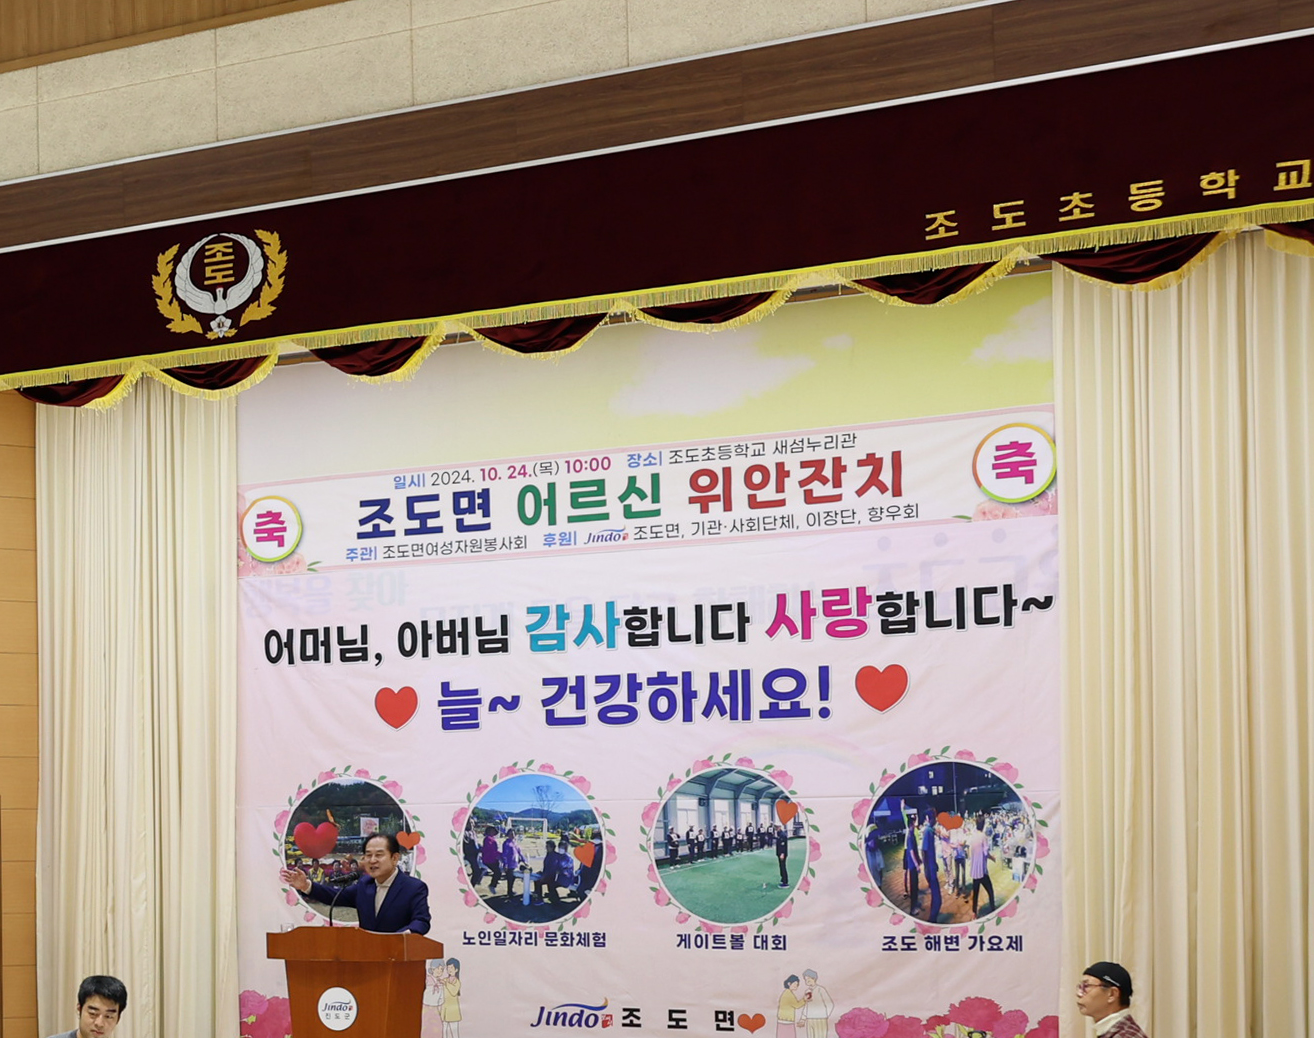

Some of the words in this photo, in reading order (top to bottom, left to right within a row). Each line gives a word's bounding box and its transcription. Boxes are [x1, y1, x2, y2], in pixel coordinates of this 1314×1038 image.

[204, 241, 235, 286] 조도
[430, 469, 475, 487] 2024.
[479, 467, 502, 482] 10.
[564, 456, 612, 474] 10:00
[668, 441, 766, 465] 조도초등학교
[772, 432, 857, 456] 새섬누리관
[989, 437, 1039, 484] 축
[356, 487, 492, 540] 조도면
[517, 472, 662, 527] 어르신
[688, 450, 903, 514] 위안잔치
[251, 506, 286, 549] 축
[584, 525, 626, 545] Jindo
[632, 523, 685, 542] 조도면,
[805, 508, 862, 528] 이장단,
[867, 503, 920, 523] 향우회
[382, 535, 528, 561] 조도면여성자원봉사회
[263, 623, 383, 667] 어머님,
[397, 613, 510, 659] 아버님
[524, 600, 751, 652] 감사합니다
[765, 583, 1055, 641] 사랑합니다~
[437, 680, 521, 732] 늘~
[540, 664, 832, 728] 건강하세요!
[462, 930, 539, 948] 노인일자리
[544, 931, 607, 948] 문화체험
[676, 933, 745, 951] 게이트볼
[753, 934, 788, 951] 대회
[881, 935, 918, 952] 조도
[924, 935, 961, 952] 해변
[967, 935, 1024, 952] 가요제
[322, 1001, 350, 1012] Jindo
[530, 999, 606, 1029] Jindo
